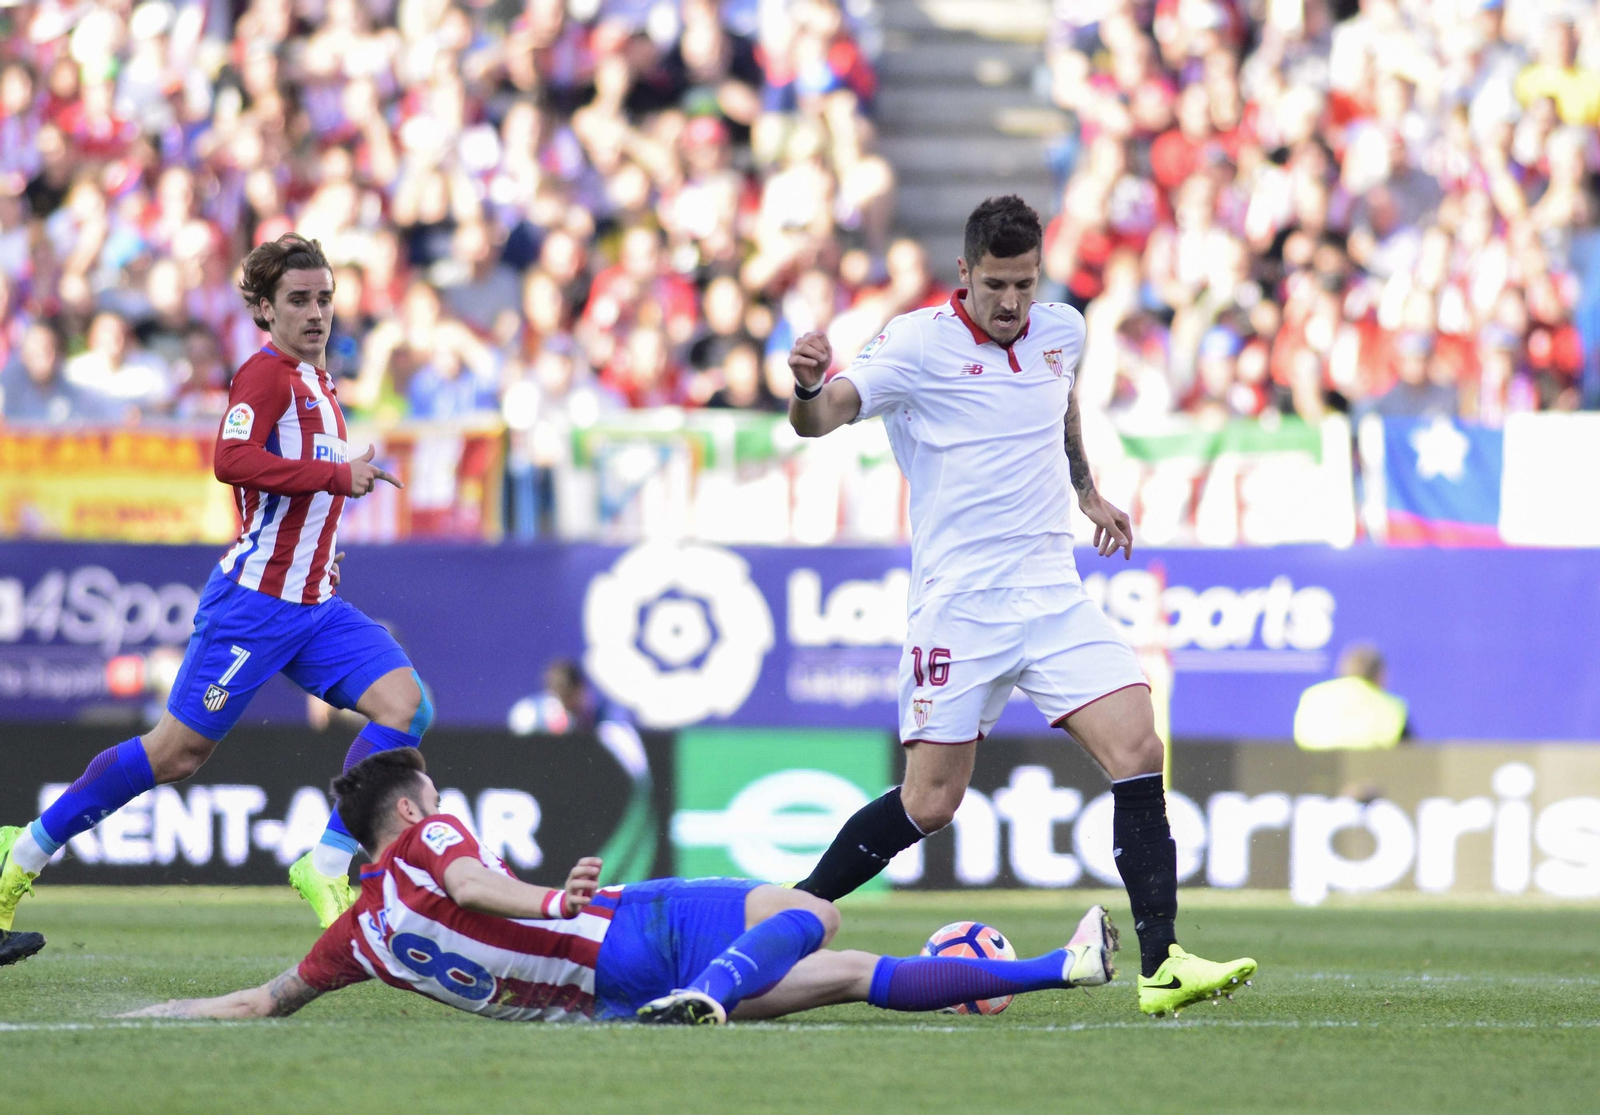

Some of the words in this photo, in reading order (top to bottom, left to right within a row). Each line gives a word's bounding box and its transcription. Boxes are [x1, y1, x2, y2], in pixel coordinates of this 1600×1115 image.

[225, 427, 248, 435] LaLiga
[218, 644, 252, 687] 7
[911, 646, 951, 687] 16
[389, 931, 497, 1002] 8
